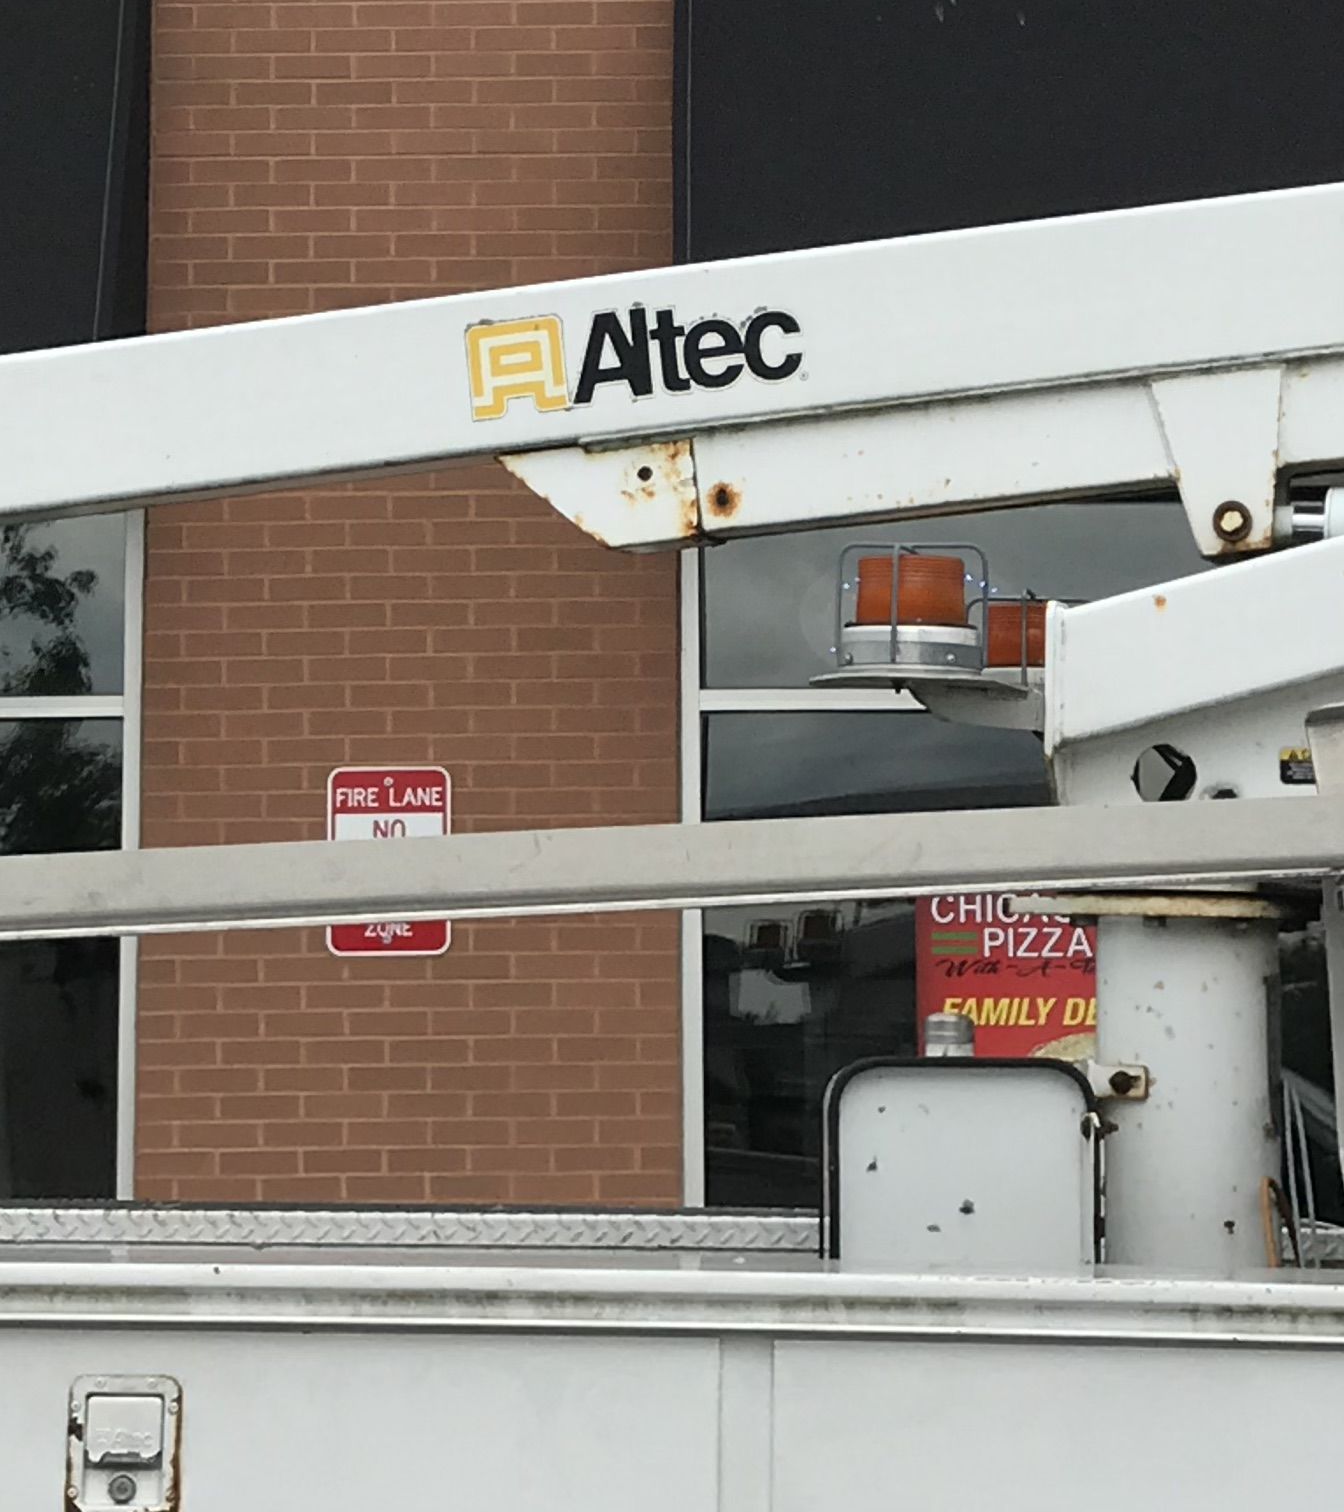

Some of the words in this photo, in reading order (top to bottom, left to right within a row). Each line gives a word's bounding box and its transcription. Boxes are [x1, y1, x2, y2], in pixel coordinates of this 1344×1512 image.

[335, 787, 379, 807] FIRE
[389, 787, 443, 807] LANE
[373, 819, 406, 838] NO
[983, 927, 1094, 957] PIZZA
[944, 997, 1057, 1026] FAMILY
